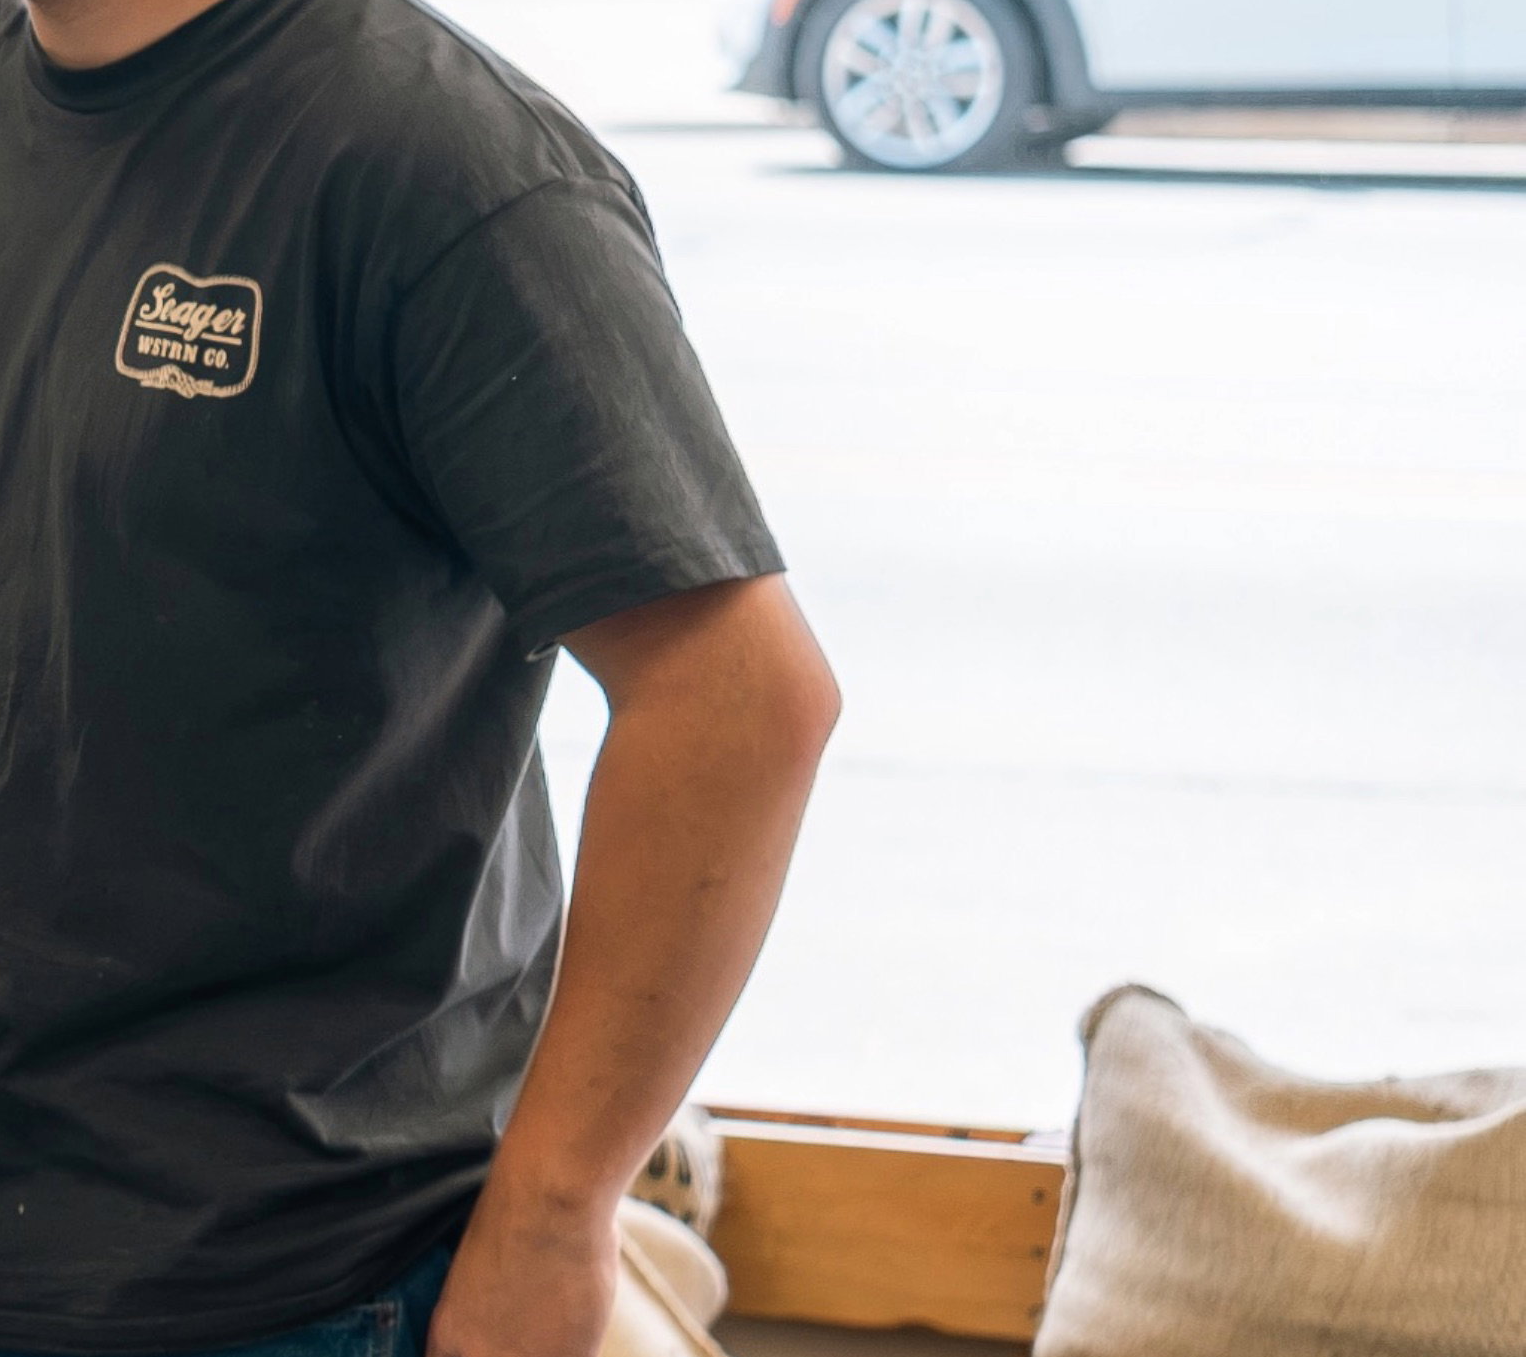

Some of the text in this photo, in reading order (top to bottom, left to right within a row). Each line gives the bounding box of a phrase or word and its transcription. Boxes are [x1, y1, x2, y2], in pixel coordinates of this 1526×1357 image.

[139, 283, 246, 341] Seager
[137, 334, 229, 370] WSTRN CO.
